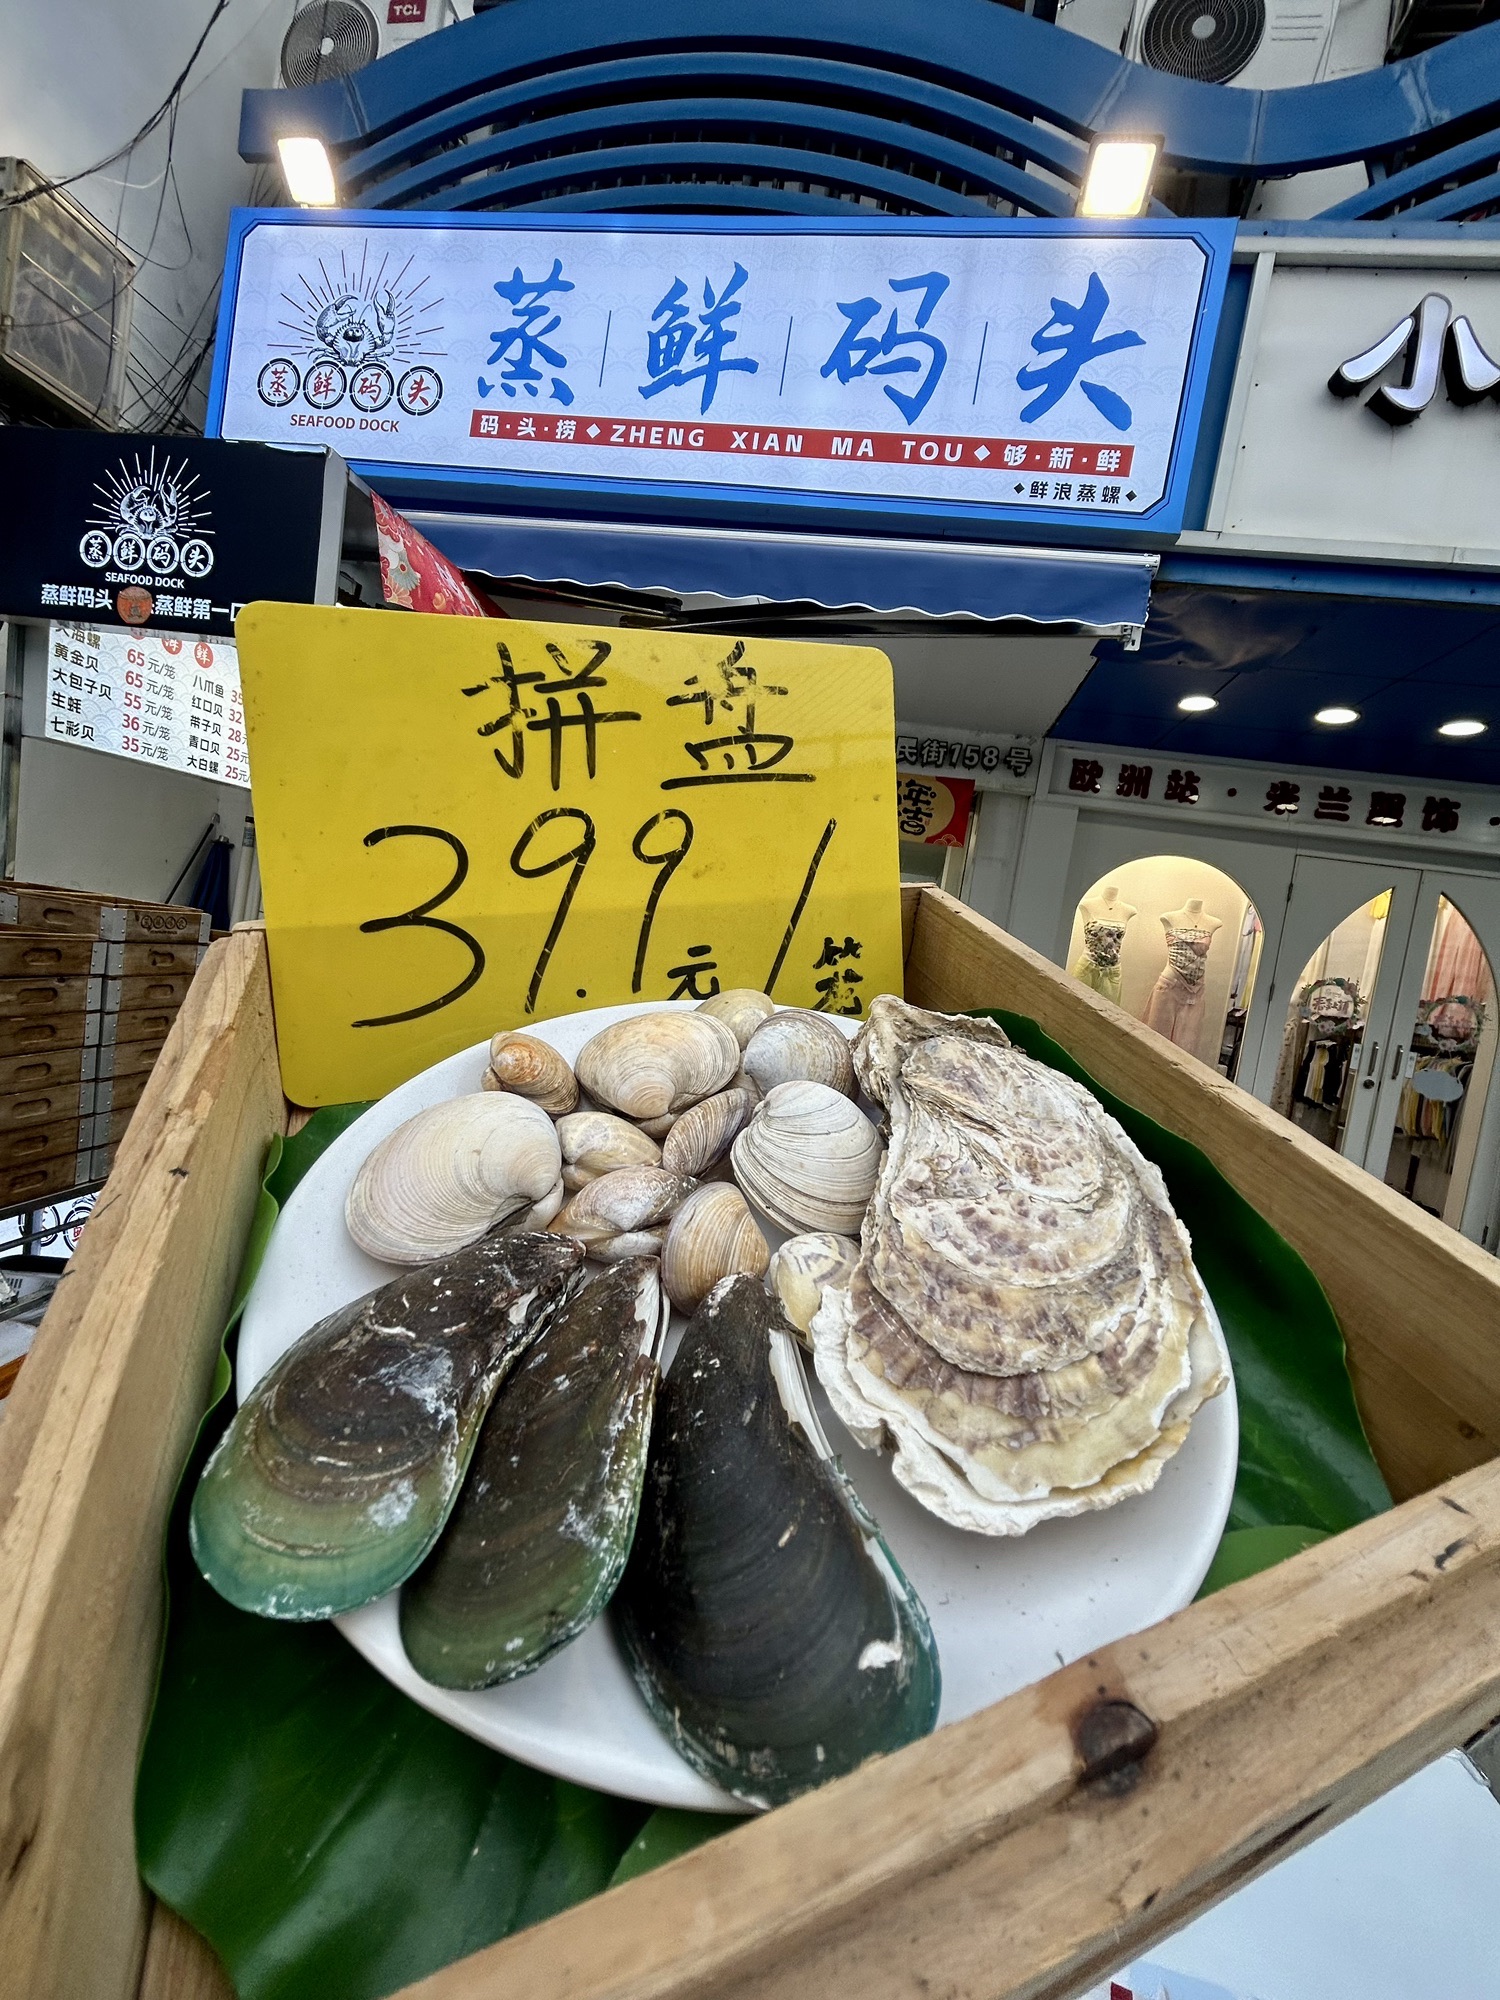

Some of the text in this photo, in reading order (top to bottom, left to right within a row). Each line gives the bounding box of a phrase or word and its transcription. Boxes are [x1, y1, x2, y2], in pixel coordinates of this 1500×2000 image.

[393, 4, 421, 16] TCL
[477, 258, 1147, 431] 蒸鲜码头
[1333, 292, 1500, 418] 小
[267, 366, 432, 407] 蒸鲜码头
[290, 414, 400, 433] SEAFOOD DOCK
[609, 424, 705, 447] ZHENG
[730, 430, 803, 453] XIAN
[830, 436, 875, 457] MA
[901, 440, 963, 462] TOU
[1029, 480, 1121, 504] 鲜浪蒸螺
[87, 536, 206, 571] 蒸鲜码头
[105, 571, 185, 589] SEAFOOD DOCK
[41, 583, 247, 622] 蒸鲜码头 蒸鲜第一口
[54, 642, 99, 673] 黄金贝
[52, 668, 112, 701] 大包子贝
[193, 675, 225, 699] 八爪鱼
[51, 690, 82, 714] 生蚝
[191, 695, 242, 725] 红口贝 32
[460, 640, 818, 792] 拼盘
[50, 716, 95, 742] 七彩贝
[190, 714, 222, 737] 带子贝
[189, 734, 220, 756] 青口贝
[187, 754, 219, 775] 大白螺
